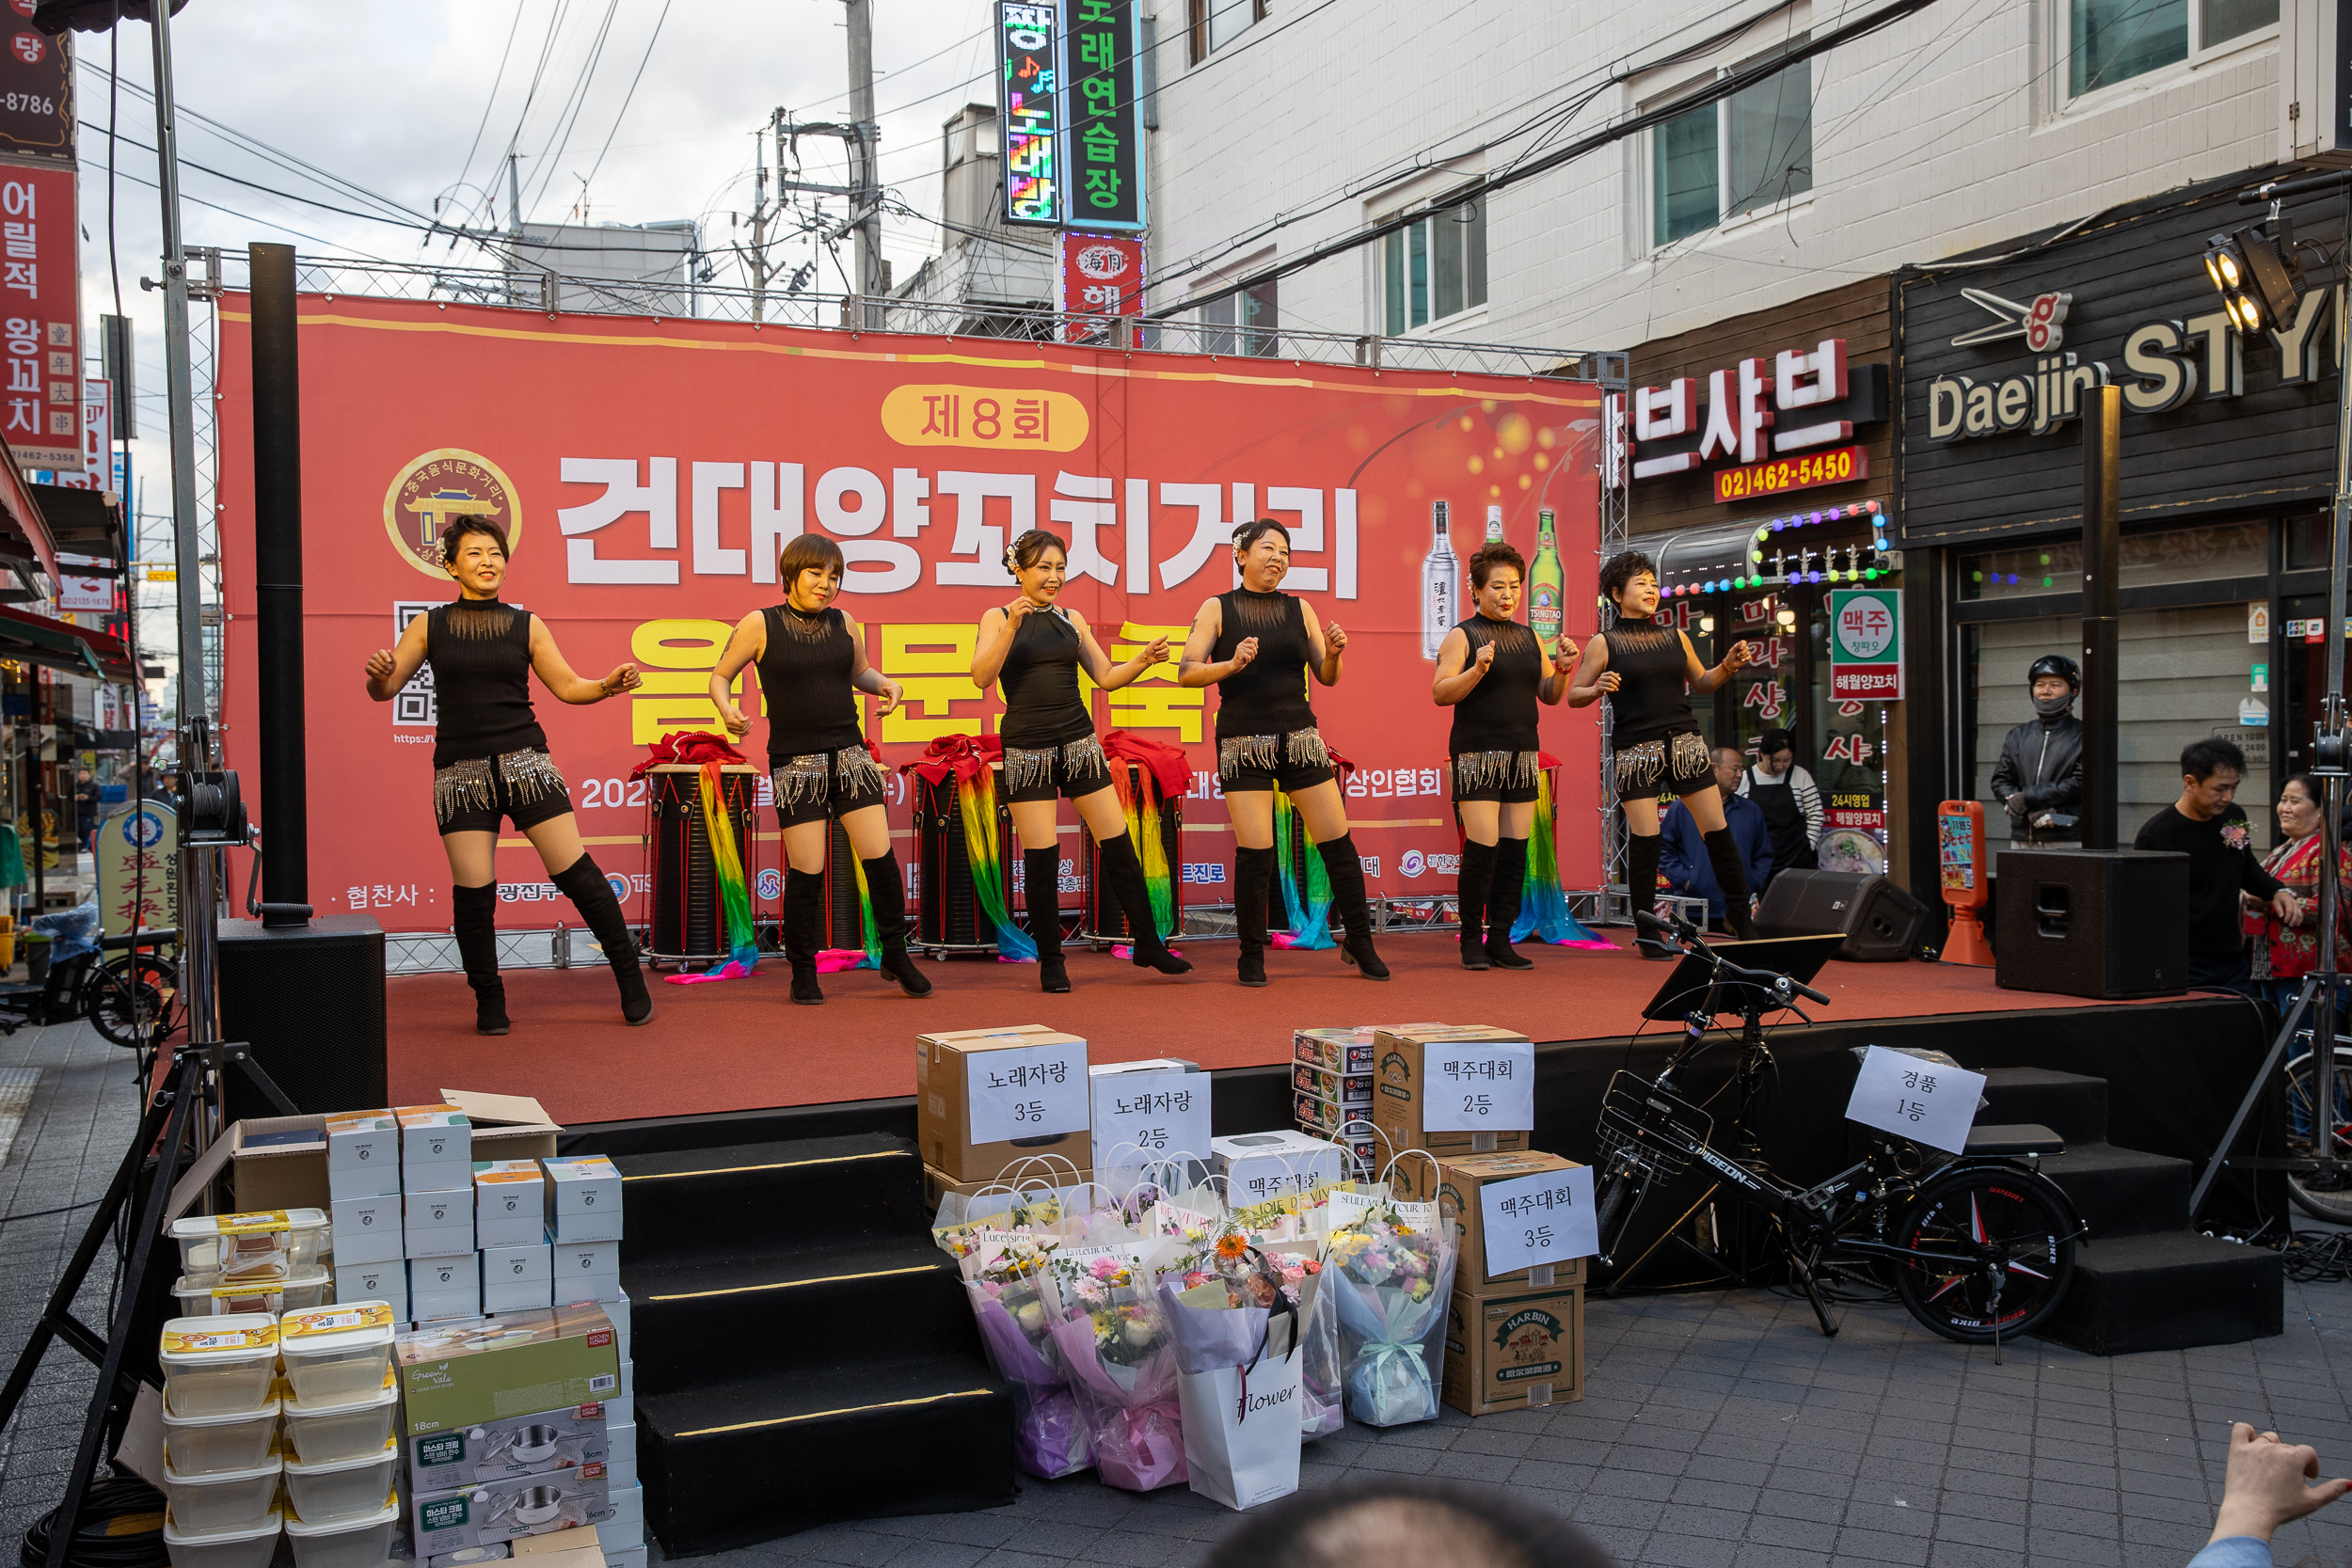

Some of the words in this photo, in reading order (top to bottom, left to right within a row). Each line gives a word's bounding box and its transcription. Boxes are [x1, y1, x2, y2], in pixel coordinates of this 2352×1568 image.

[3, 182, 38, 299] 어릴적
[1930, 356, 2096, 439] Daejin
[405, 461, 501, 498] 중국음식문화거리
[1721, 451, 1851, 498] 02)462-5450
[1530, 610, 1562, 619] TSINGTAO
[1843, 610, 1887, 637] 맥주
[1836, 673, 1897, 689] 해월양꼬치
[1345, 768, 1441, 799] 상인협회
[1832, 794, 1870, 808] 24시영업
[1836, 812, 1881, 826] 해월양꼬치
[347, 883, 419, 910] 협찬사
[1386, 1053, 1406, 1068] HARBIN
[1443, 1060, 1513, 1082] 맥주대회
[988, 1060, 1069, 1089] 노래자랑
[1901, 1069, 1938, 1094] 경품
[1014, 1100, 1046, 1122] 3등
[1114, 1090, 1193, 1116] 노래자랑
[1464, 1094, 1493, 1116] 2등
[1896, 1099, 1926, 1122] 1등
[1138, 1128, 1169, 1149] 2등
[1501, 1186, 1572, 1219] 맥주대회
[983, 1232, 1007, 1243] Luce
[1524, 1225, 1555, 1248] 3등
[1507, 1311, 1549, 1330] HARBIN
[589, 1333, 609, 1341] KITCHEN
[412, 1370, 442, 1381] Green
[434, 1373, 452, 1384] Vale
[1236, 1385, 1296, 1418] Flower
[414, 1421, 439, 1431] 18cm
[423, 1443, 444, 1453] 마스타
[423, 1451, 436, 1460] 스텐
[583, 1449, 603, 1459] 16cm
[426, 1506, 448, 1517] 마스타
[586, 1509, 606, 1519] 16cm
